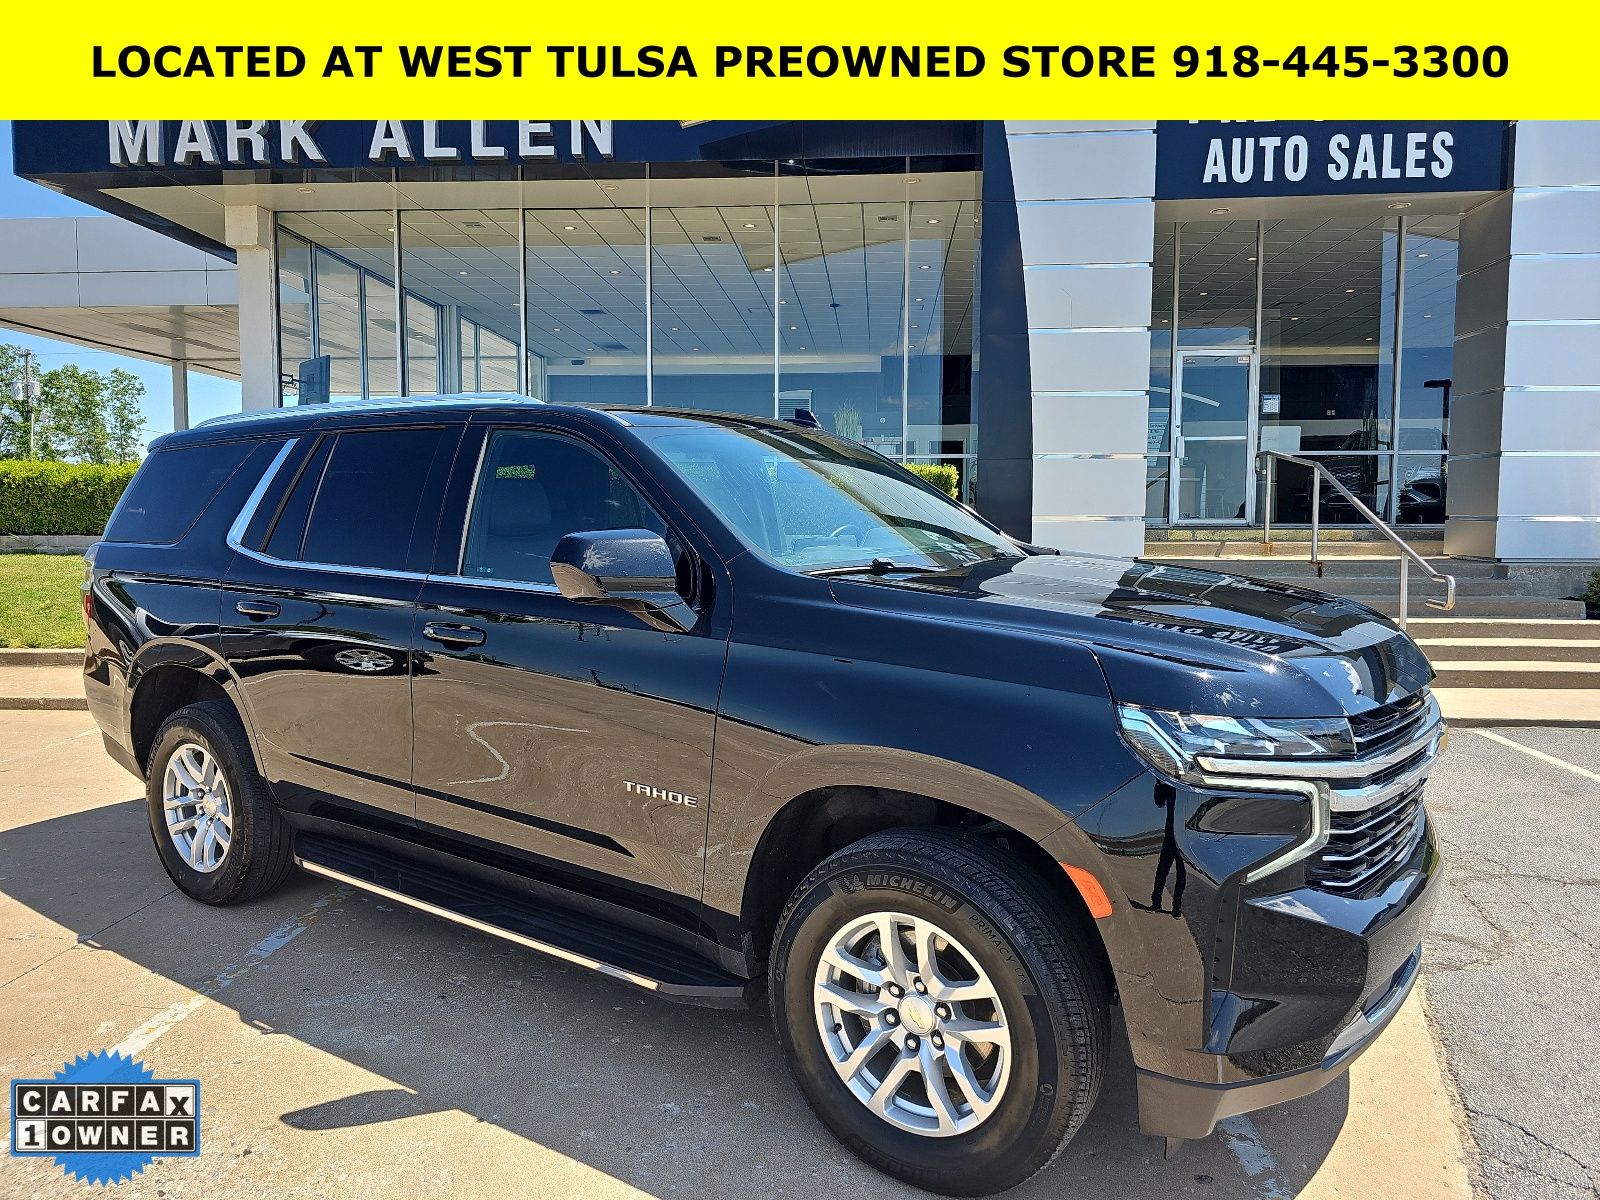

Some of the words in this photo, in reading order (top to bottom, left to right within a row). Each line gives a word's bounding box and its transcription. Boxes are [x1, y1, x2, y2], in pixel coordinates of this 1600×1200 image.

[108, 119, 326, 166] MARK
[368, 119, 615, 161] ALLEN
[1202, 135, 1309, 184] AUTO
[1326, 131, 1454, 181] SALES
[622, 779, 699, 808] TAHOE
[866, 874, 958, 909] MICHELIN
[967, 914, 1016, 963] PRIMACY
